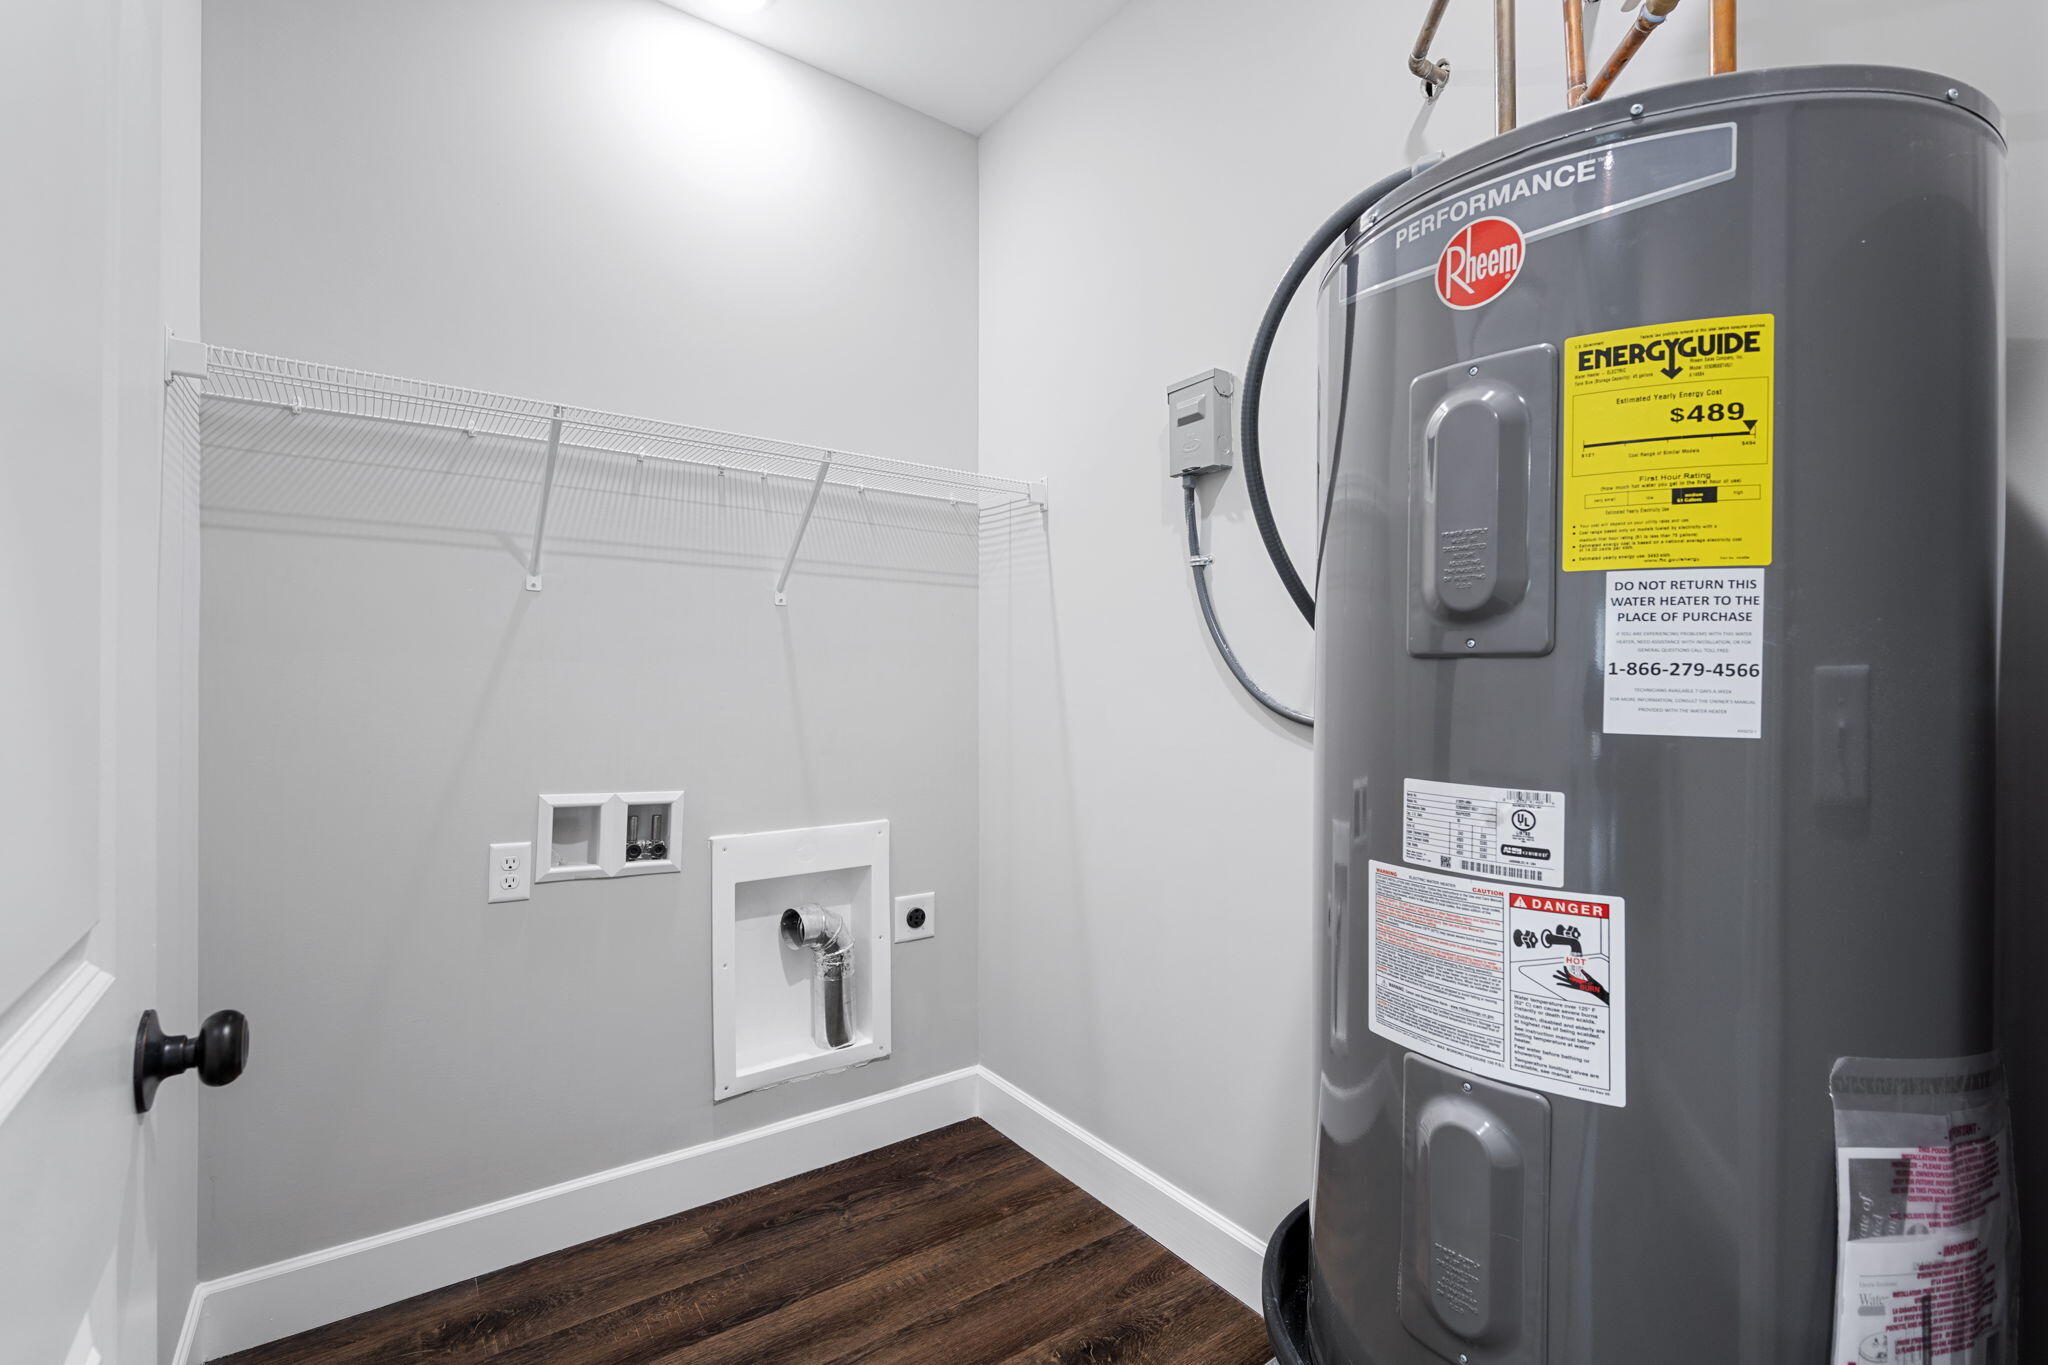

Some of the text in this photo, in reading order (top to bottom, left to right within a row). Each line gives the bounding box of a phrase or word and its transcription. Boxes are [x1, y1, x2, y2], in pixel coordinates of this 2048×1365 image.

[1396, 158, 1596, 248] PERFORMANCE
[1446, 225, 1518, 300] Rheem
[1579, 331, 1760, 373] ENERGYGUIDE
[1616, 388, 1723, 405] Estimated Yearly Energy Cost
[1670, 402, 1744, 424] $489
[1661, 473, 1681, 481] Hour
[1683, 472, 1711, 480] Rating
[1614, 579, 1757, 591] DO NOT RETURN THIS
[1611, 595, 1760, 607] WATER HEATER TO THE
[1617, 612, 1752, 622] PLACE OF PURCHASE
[1608, 662, 1760, 678] 1-866-279-4566
[1517, 814, 1530, 827] UL
[1472, 887, 1505, 897] CAUTION
[1532, 899, 1603, 917] DANGER
[1566, 957, 1586, 966] HOT
[1580, 984, 1601, 993] BURN
[1530, 997, 1563, 1008] temperature
[1514, 1006, 1536, 1015] instantly
[1545, 1011, 1560, 1019] death
[1576, 1017, 1596, 1025] scalds.
[1514, 1013, 1538, 1023] Children,
[1539, 1018, 1562, 1027] disabled
[1575, 1024, 1594, 1033] elderly
[1520, 1020, 1540, 1029] highest
[1560, 1028, 1576, 1036] being
[1577, 1030, 1600, 1039] scalded.
[1525, 1028, 1554, 1038] instruction
[1555, 1034, 1575, 1042] manual
[1577, 1038, 1596, 1046] before
[1514, 1032, 1532, 1040] setting
[1533, 1035, 1566, 1046] temperature
[1542, 1050, 1560, 1059] before
[1561, 1054, 1582, 1064] bathing
